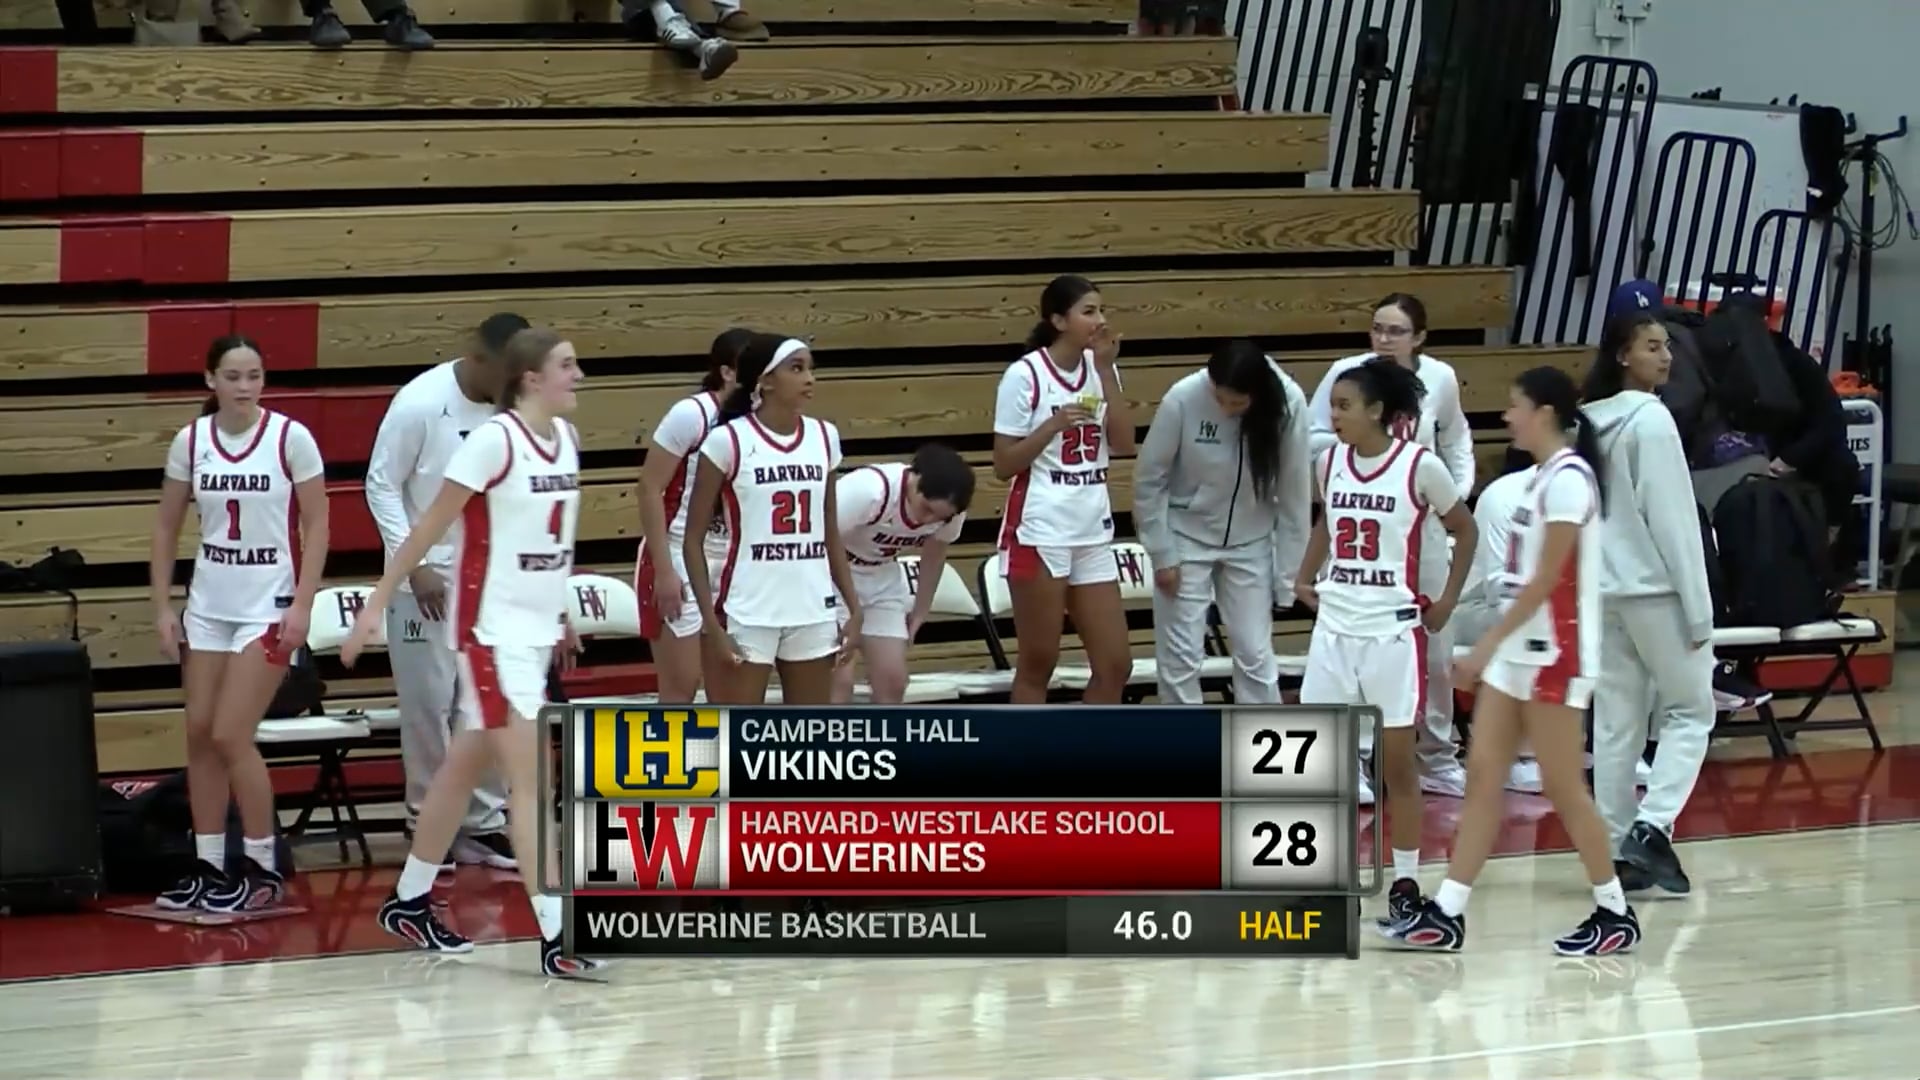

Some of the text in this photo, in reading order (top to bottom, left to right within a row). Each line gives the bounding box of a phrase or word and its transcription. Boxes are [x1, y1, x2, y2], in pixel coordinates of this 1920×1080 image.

[1061, 423, 1102, 465] 25
[200, 474, 270, 491] HARVARD
[754, 465, 822, 485] HARVARD
[771, 489, 811, 535] 21
[1331, 492, 1396, 513] HARVARD
[226, 499, 241, 541] 1
[750, 541, 826, 561] WESTLAKE
[1336, 516, 1380, 561] 23
[202, 543, 278, 565] WESTLAKE
[573, 585, 608, 621] HW
